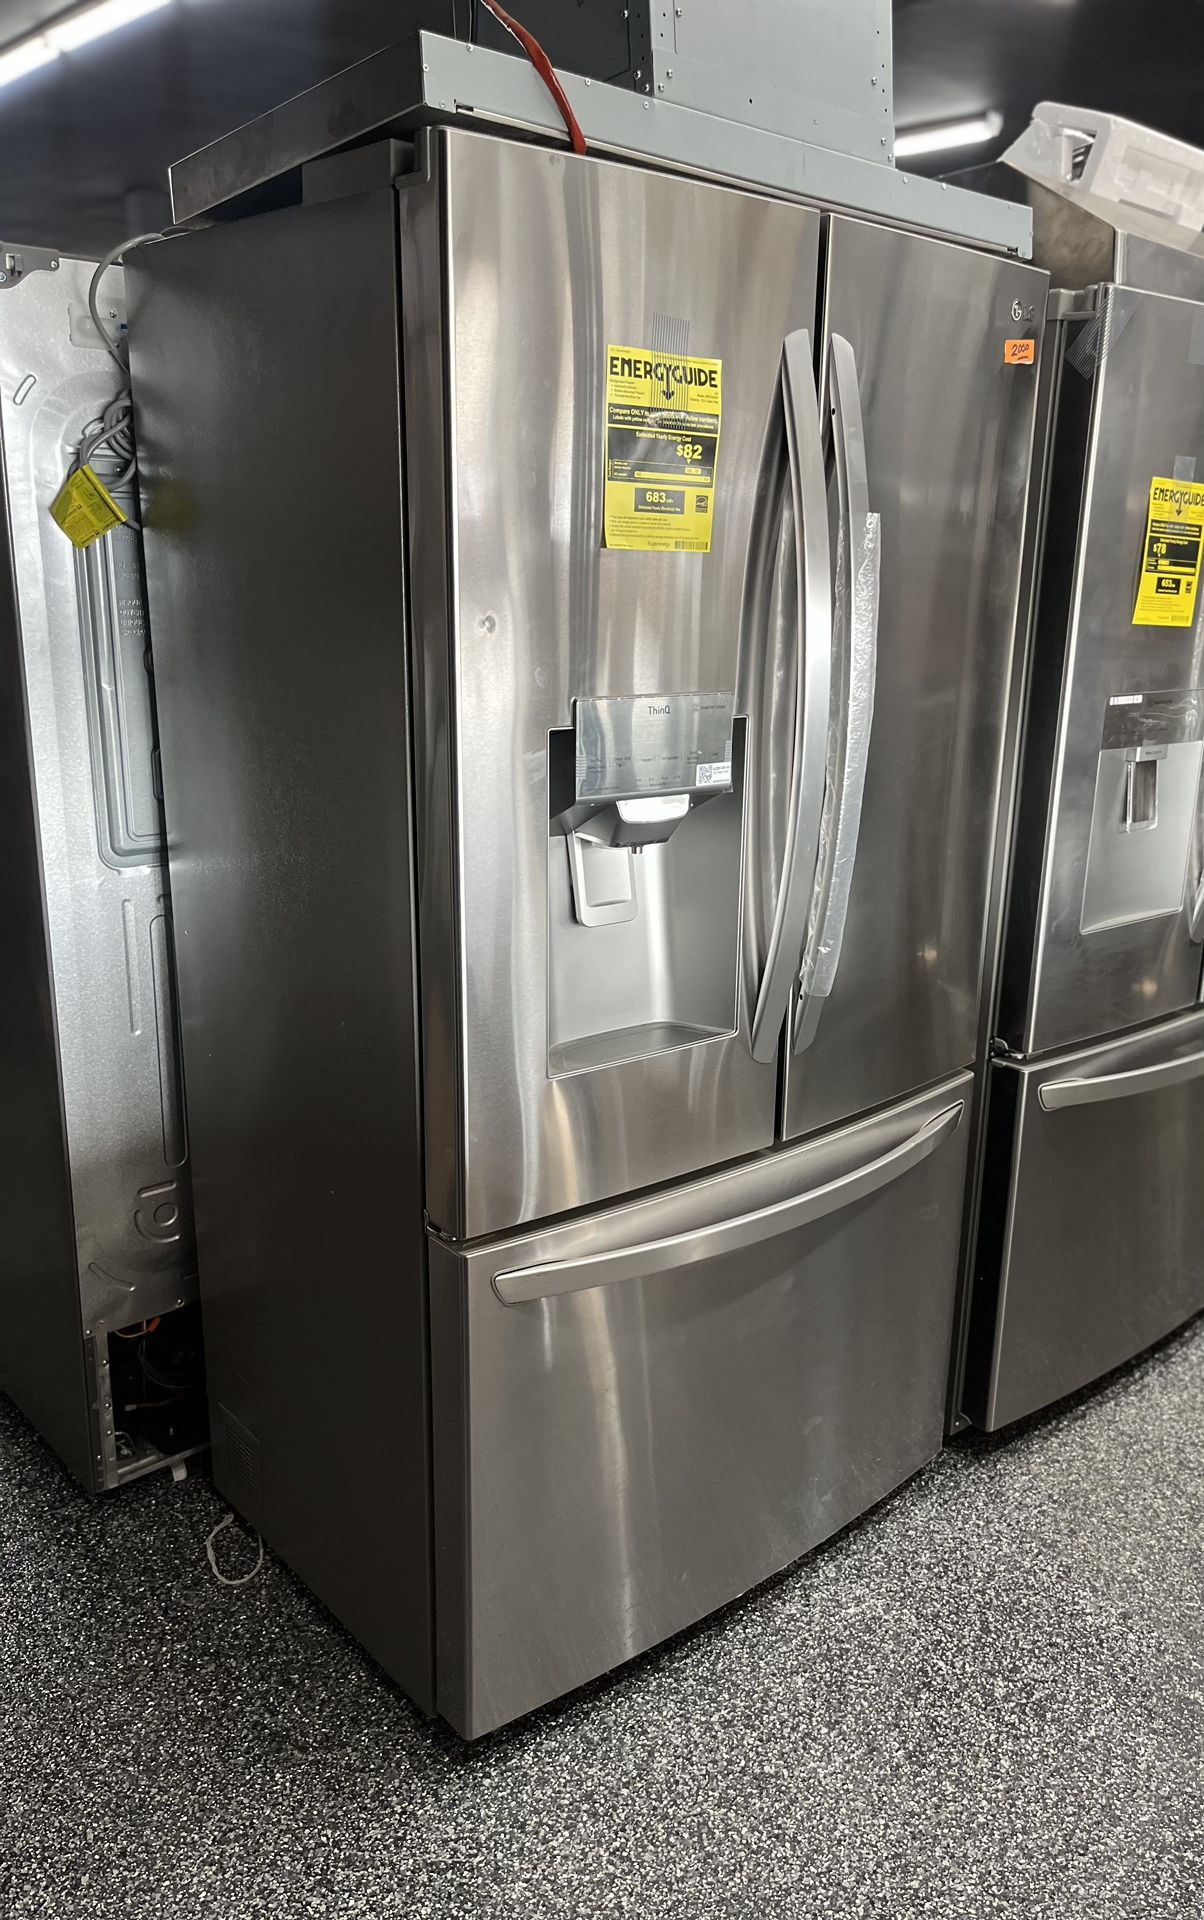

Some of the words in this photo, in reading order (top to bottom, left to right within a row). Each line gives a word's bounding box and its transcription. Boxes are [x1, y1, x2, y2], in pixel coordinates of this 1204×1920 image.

[1011, 343, 1030, 357] 2000
[609, 356, 719, 389] ENERGYGUIDE
[609, 407, 631, 416] Compare
[676, 444, 703, 460] $82
[645, 491, 666, 503] 683
[1152, 543, 1167, 555] $78
[1161, 579, 1172, 588] 653
[648, 705, 671, 715] ThinQ
